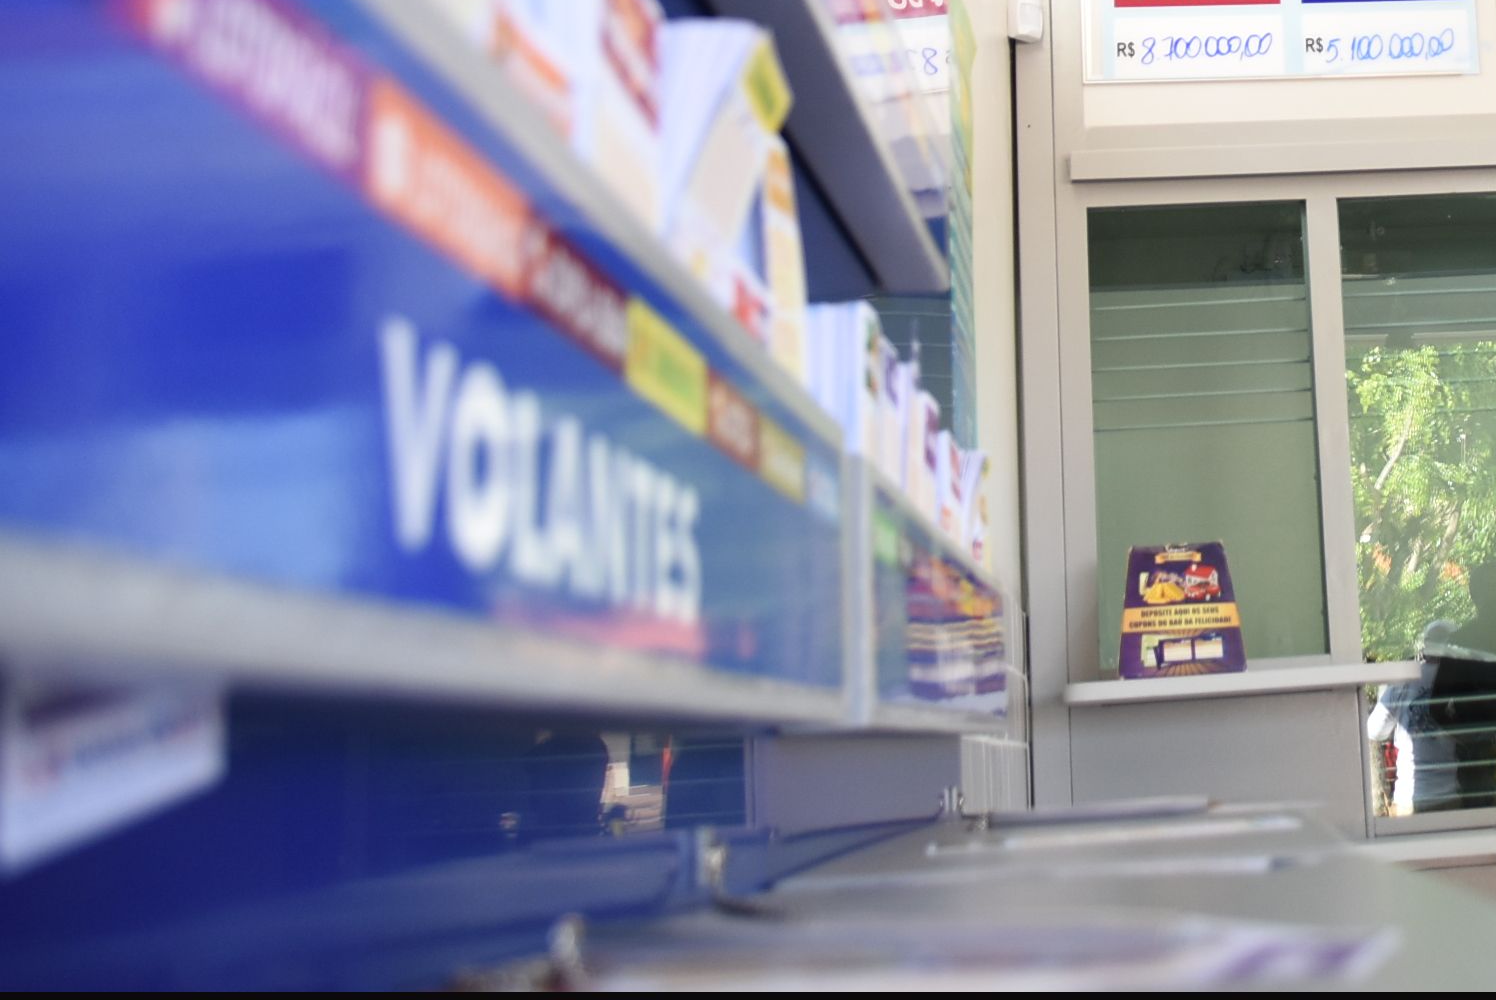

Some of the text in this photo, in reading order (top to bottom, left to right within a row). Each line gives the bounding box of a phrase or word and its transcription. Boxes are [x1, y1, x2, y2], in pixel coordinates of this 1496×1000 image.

[1117, 41, 1136, 58] R$
[1305, 37, 1324, 53] R$
[382, 314, 701, 628] VOLANTES
